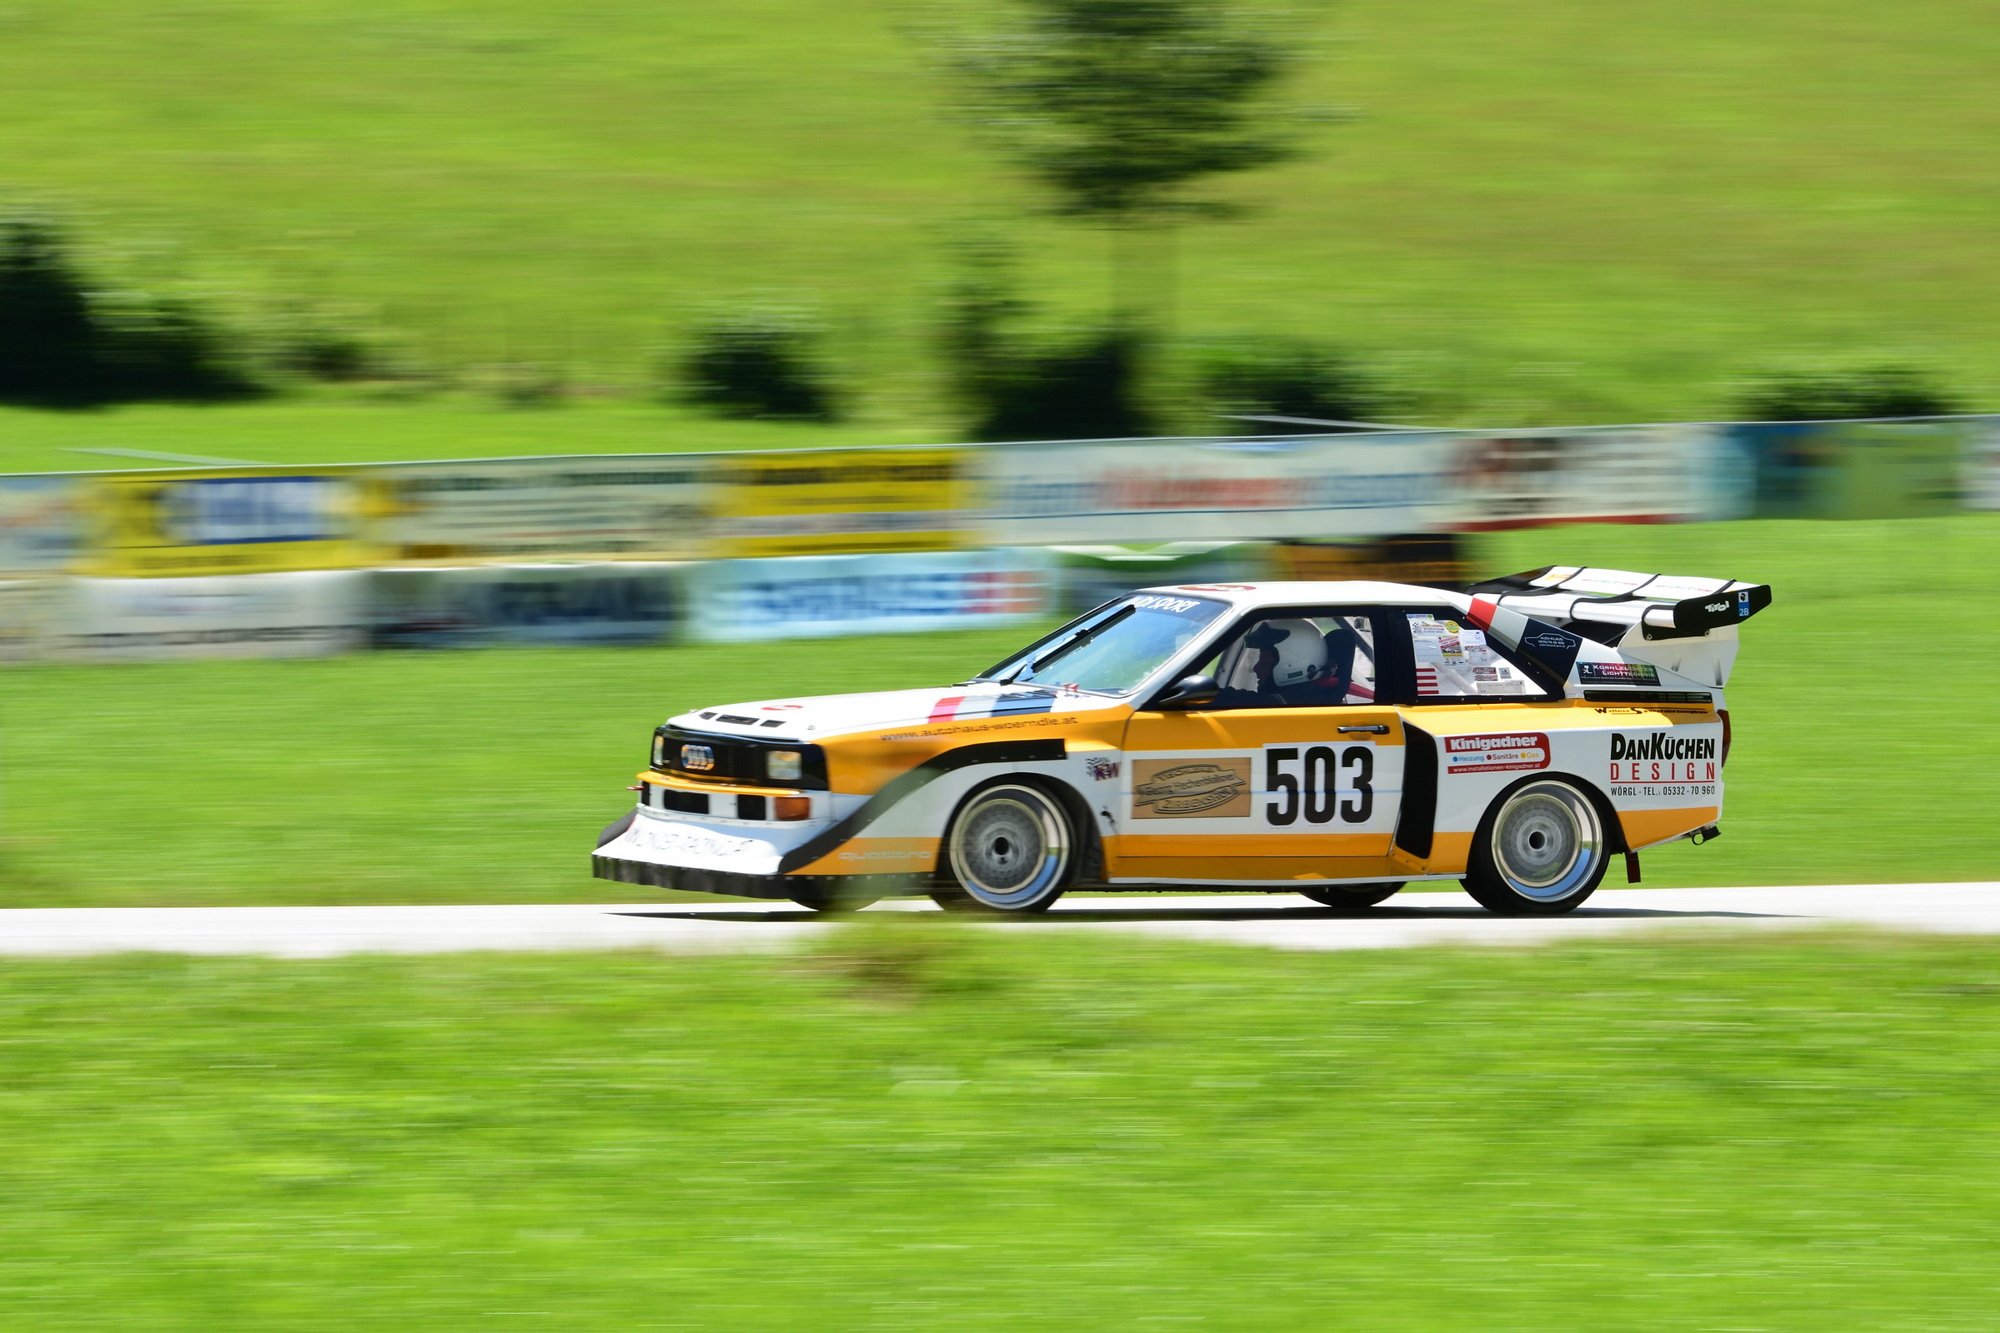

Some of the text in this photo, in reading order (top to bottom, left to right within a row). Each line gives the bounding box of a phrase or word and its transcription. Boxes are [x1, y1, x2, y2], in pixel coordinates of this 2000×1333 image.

[1450, 736, 1538, 750] Kinigadner
[1610, 762, 1715, 780] DESIGN
[1266, 746, 1373, 825] 503
[1611, 786, 1637, 796] WÖRGL
[1702, 786, 1715, 795] 960
[839, 851, 931, 861] quattro
